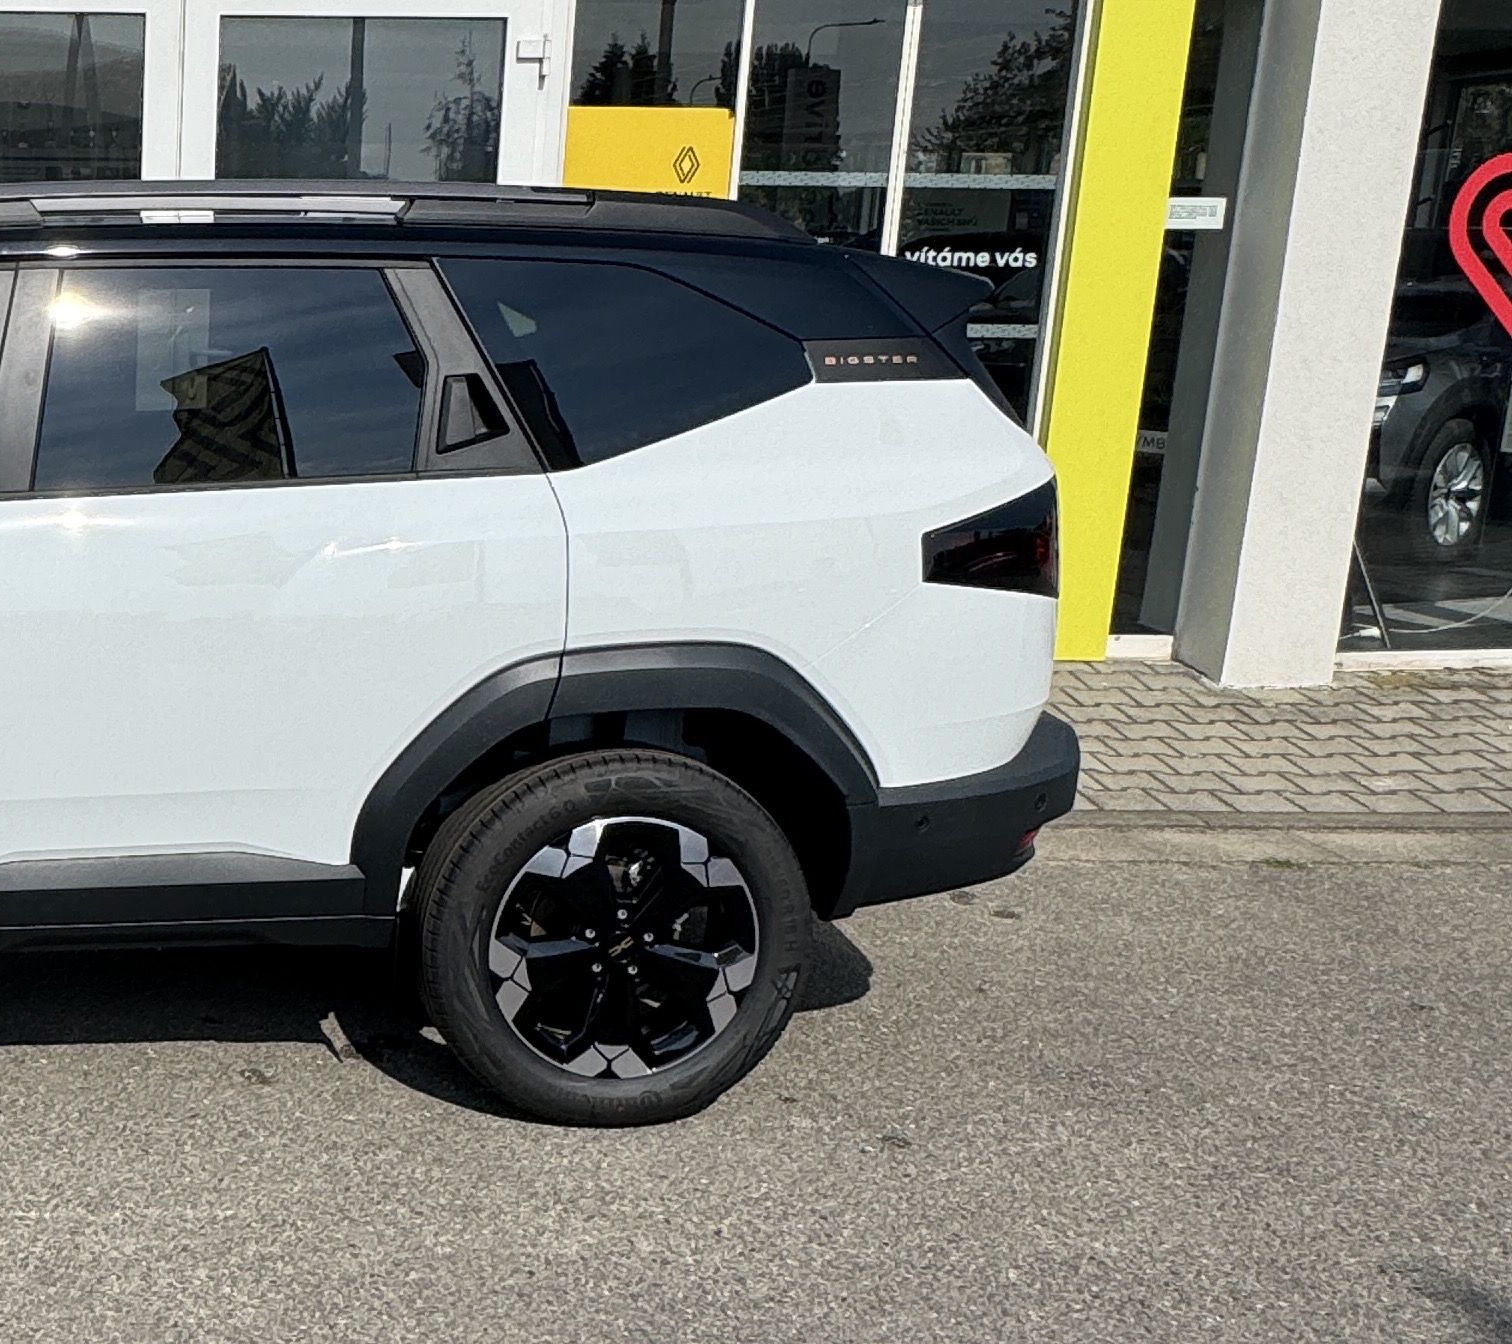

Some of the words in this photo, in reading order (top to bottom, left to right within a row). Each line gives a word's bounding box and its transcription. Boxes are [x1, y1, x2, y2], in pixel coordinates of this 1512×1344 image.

[904, 246, 990, 267] vítáme
[995, 248, 1037, 268] vás
[824, 354, 919, 366] BIGSTER
